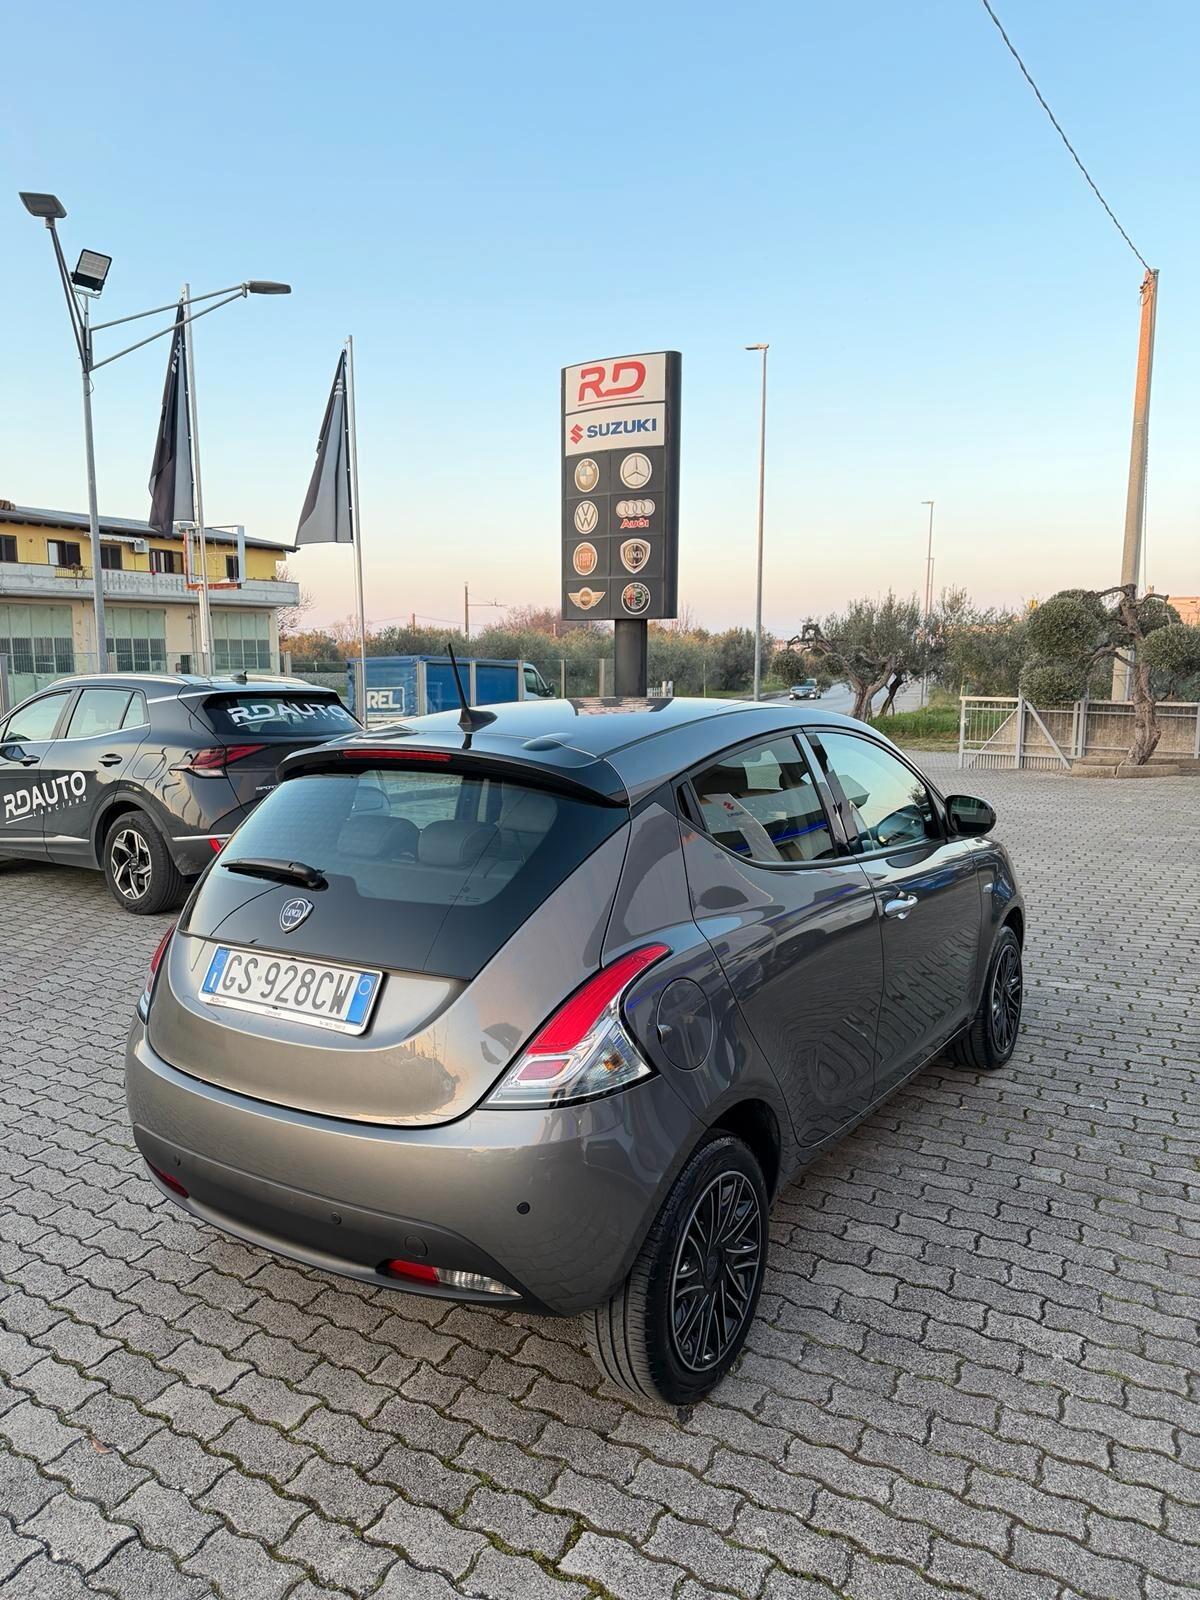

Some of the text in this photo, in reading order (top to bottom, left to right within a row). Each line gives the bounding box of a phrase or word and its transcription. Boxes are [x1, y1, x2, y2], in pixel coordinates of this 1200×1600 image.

[578, 361, 647, 401] RD
[587, 418, 656, 438] SUZUKI
[620, 517, 649, 529] Audi
[366, 690, 401, 708] REL
[33, 795, 87, 817] LANCIANO
